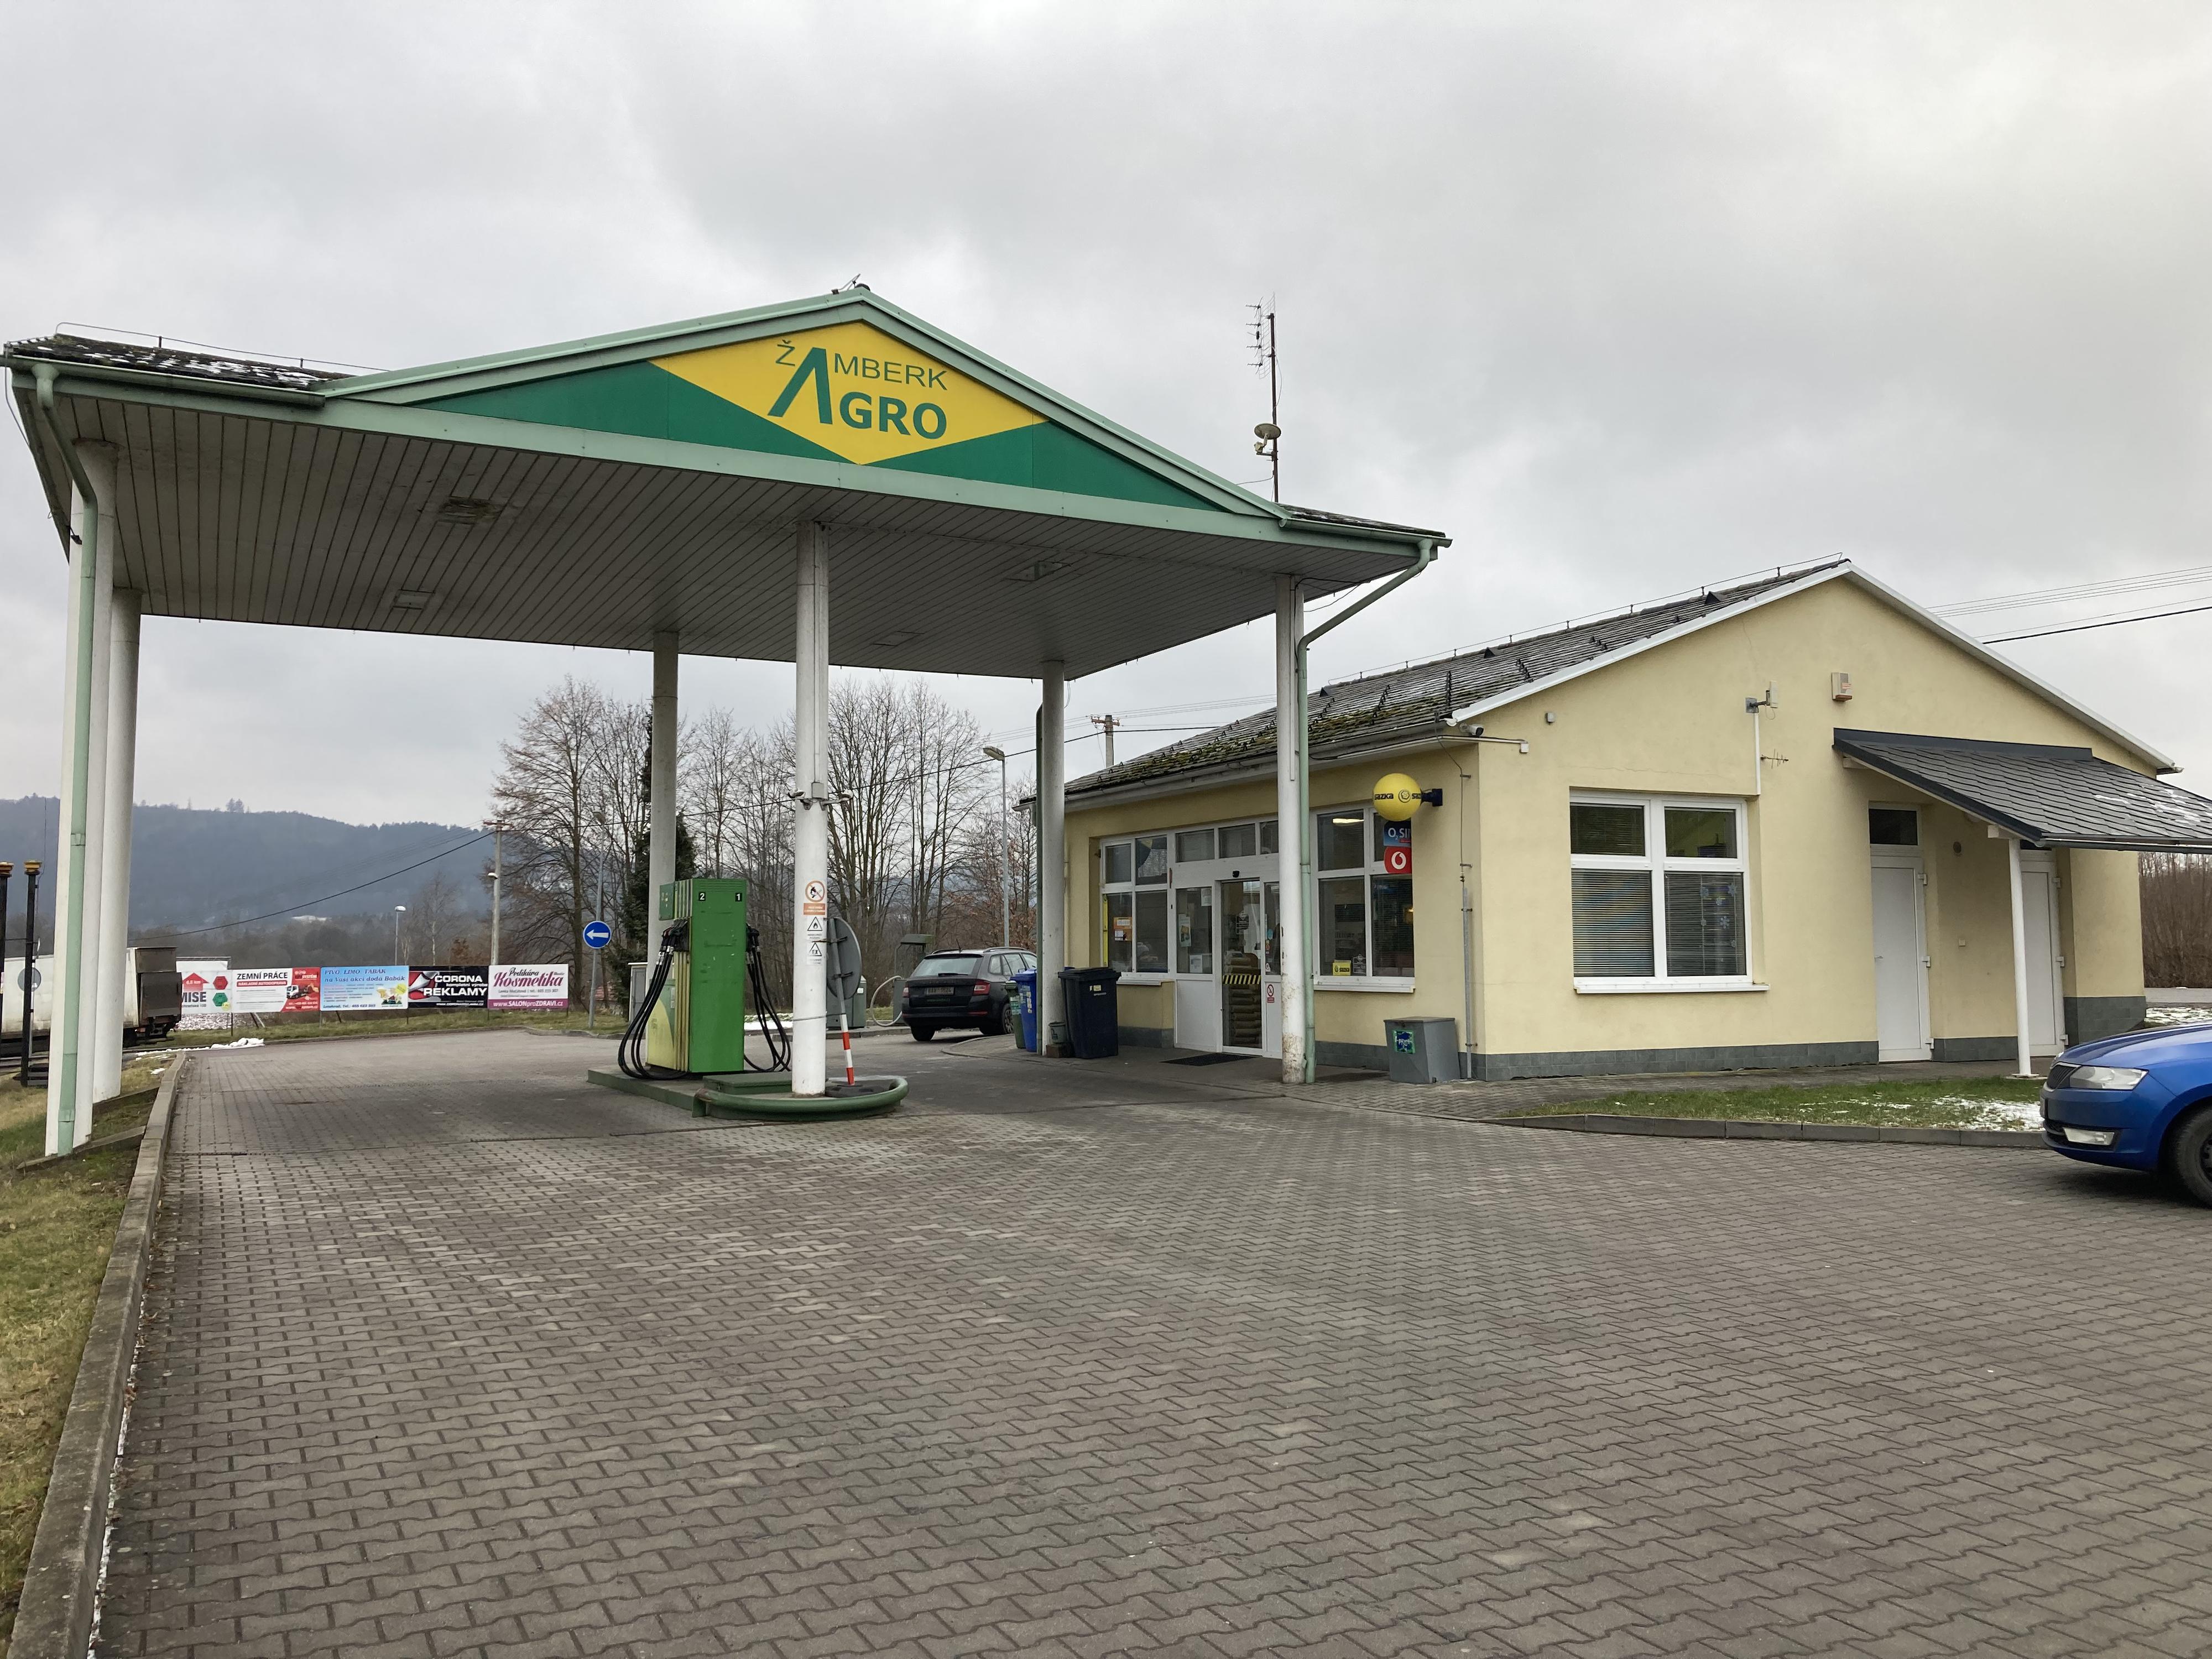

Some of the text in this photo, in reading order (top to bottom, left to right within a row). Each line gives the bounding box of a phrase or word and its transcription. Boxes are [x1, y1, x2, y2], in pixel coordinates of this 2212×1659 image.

[237, 971, 262, 980] ZEMNÍ
[263, 971, 288, 979] PRÁCE
[493, 971, 564, 987] Kosmetika
[424, 988, 487, 996] REKLAMY
